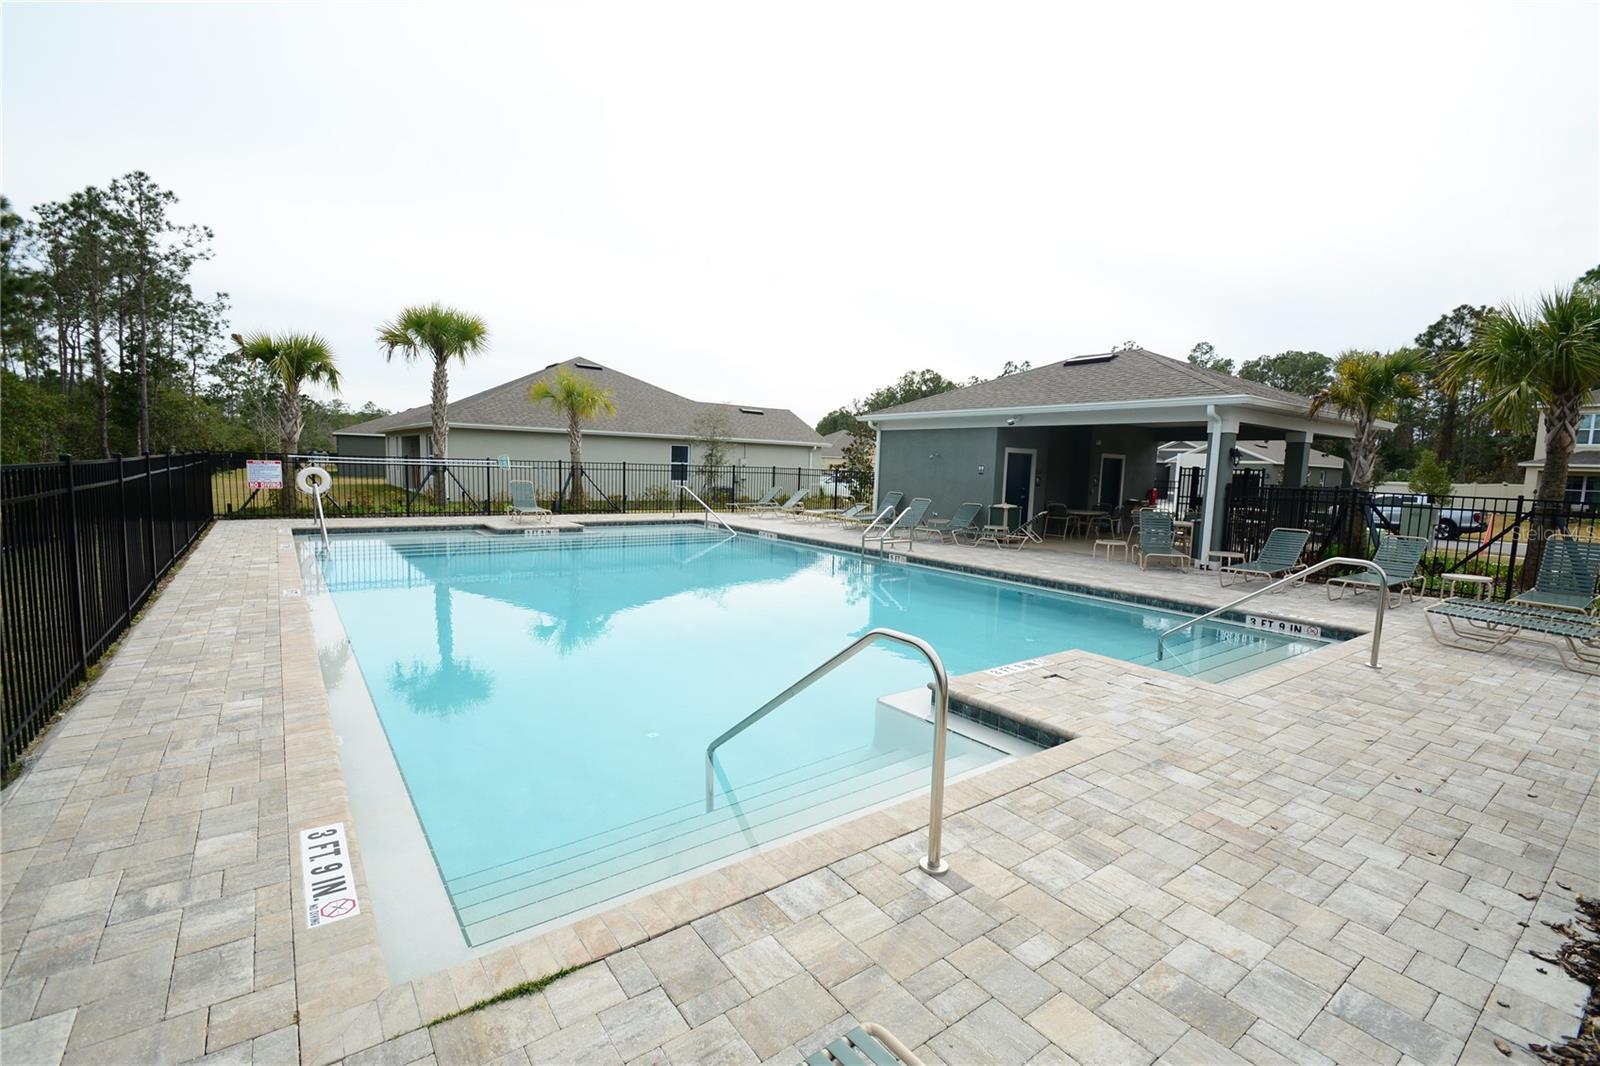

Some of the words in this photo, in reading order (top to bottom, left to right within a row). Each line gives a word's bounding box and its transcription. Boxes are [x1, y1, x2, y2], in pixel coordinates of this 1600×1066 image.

[1250, 617, 1257, 625] 3
[1261, 619, 1274, 628] FT
[1279, 622, 1285, 631] 9
[1290, 624, 1302, 633] IN
[307, 829, 337, 840] 3
[310, 862, 343, 875] 9
